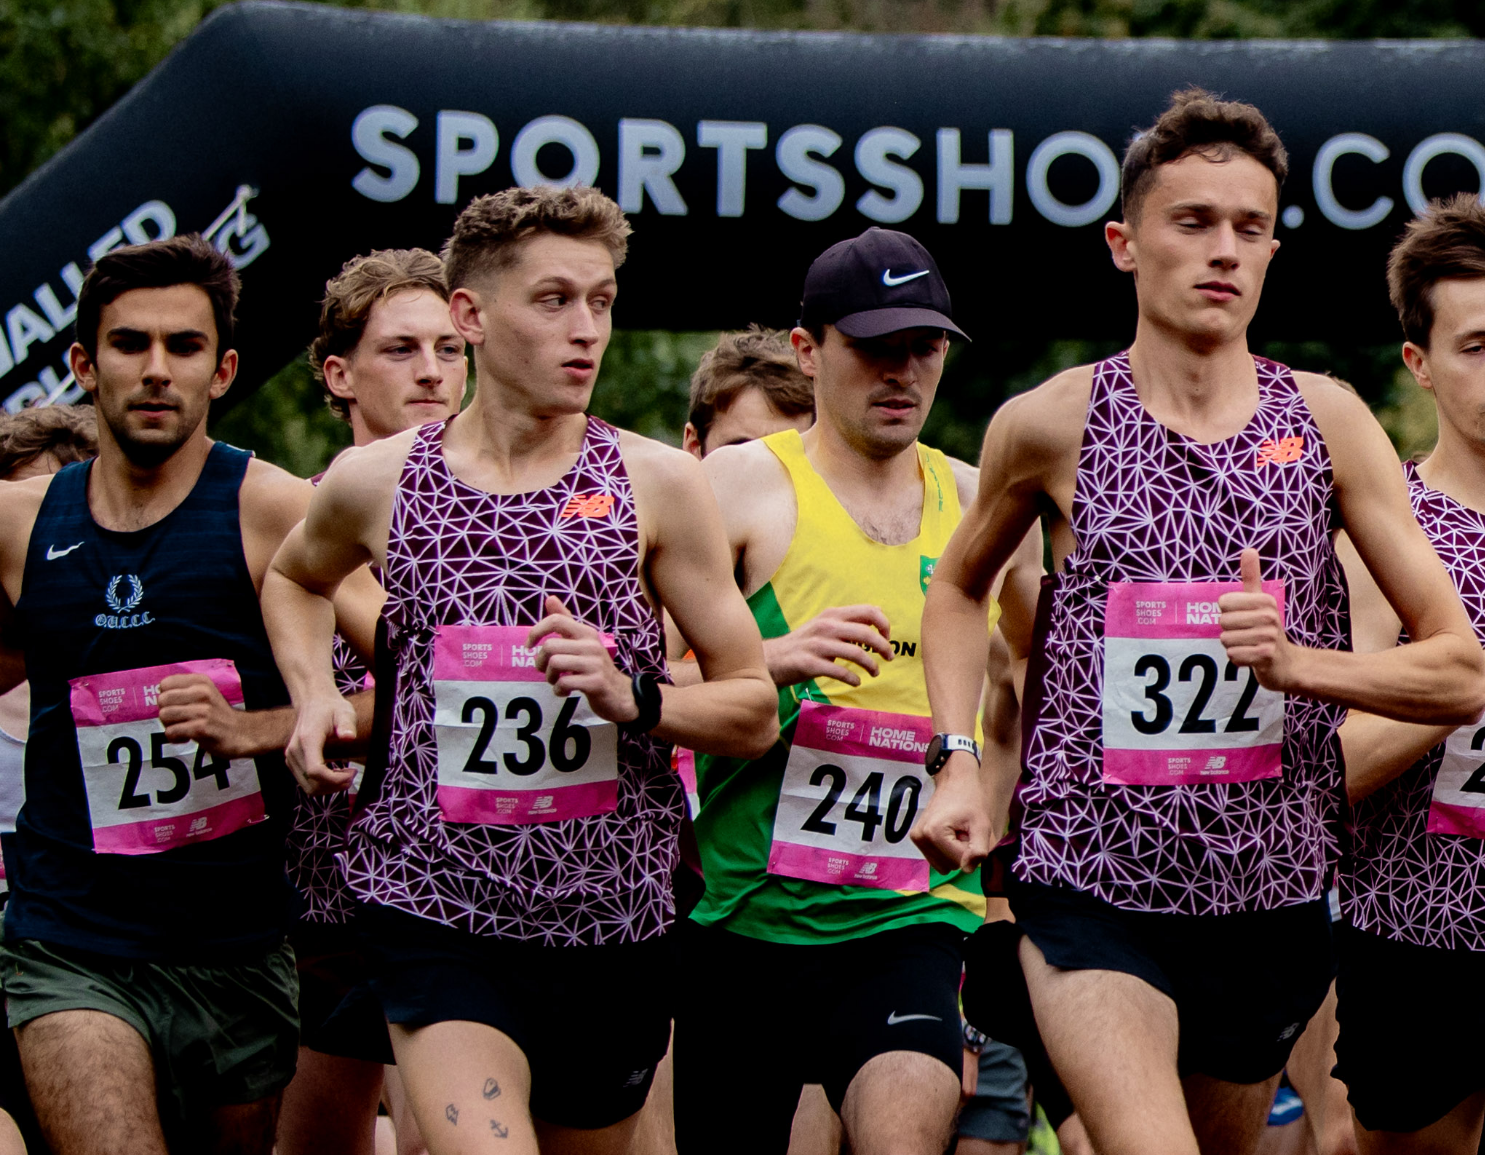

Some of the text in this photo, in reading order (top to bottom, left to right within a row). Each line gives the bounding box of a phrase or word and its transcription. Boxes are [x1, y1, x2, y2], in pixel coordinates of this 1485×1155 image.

[1135, 601, 1166, 609] SPORTS
[1186, 602, 1222, 613] HOM
[1135, 609, 1162, 617] SHOES
[462, 643, 492, 651] SPORTS
[462, 652, 488, 660] SHOES
[98, 688, 126, 698] SPORTS
[1130, 653, 1260, 735] 322
[100, 696, 123, 706] SHOES
[827, 719, 855, 730] SPORTS
[461, 696, 591, 776] 236
[826, 727, 850, 736] SHOES
[869, 726, 916, 741] HOME
[868, 736, 930, 753] NATIONS
[106, 732, 232, 810] 254
[800, 763, 923, 844] 240
